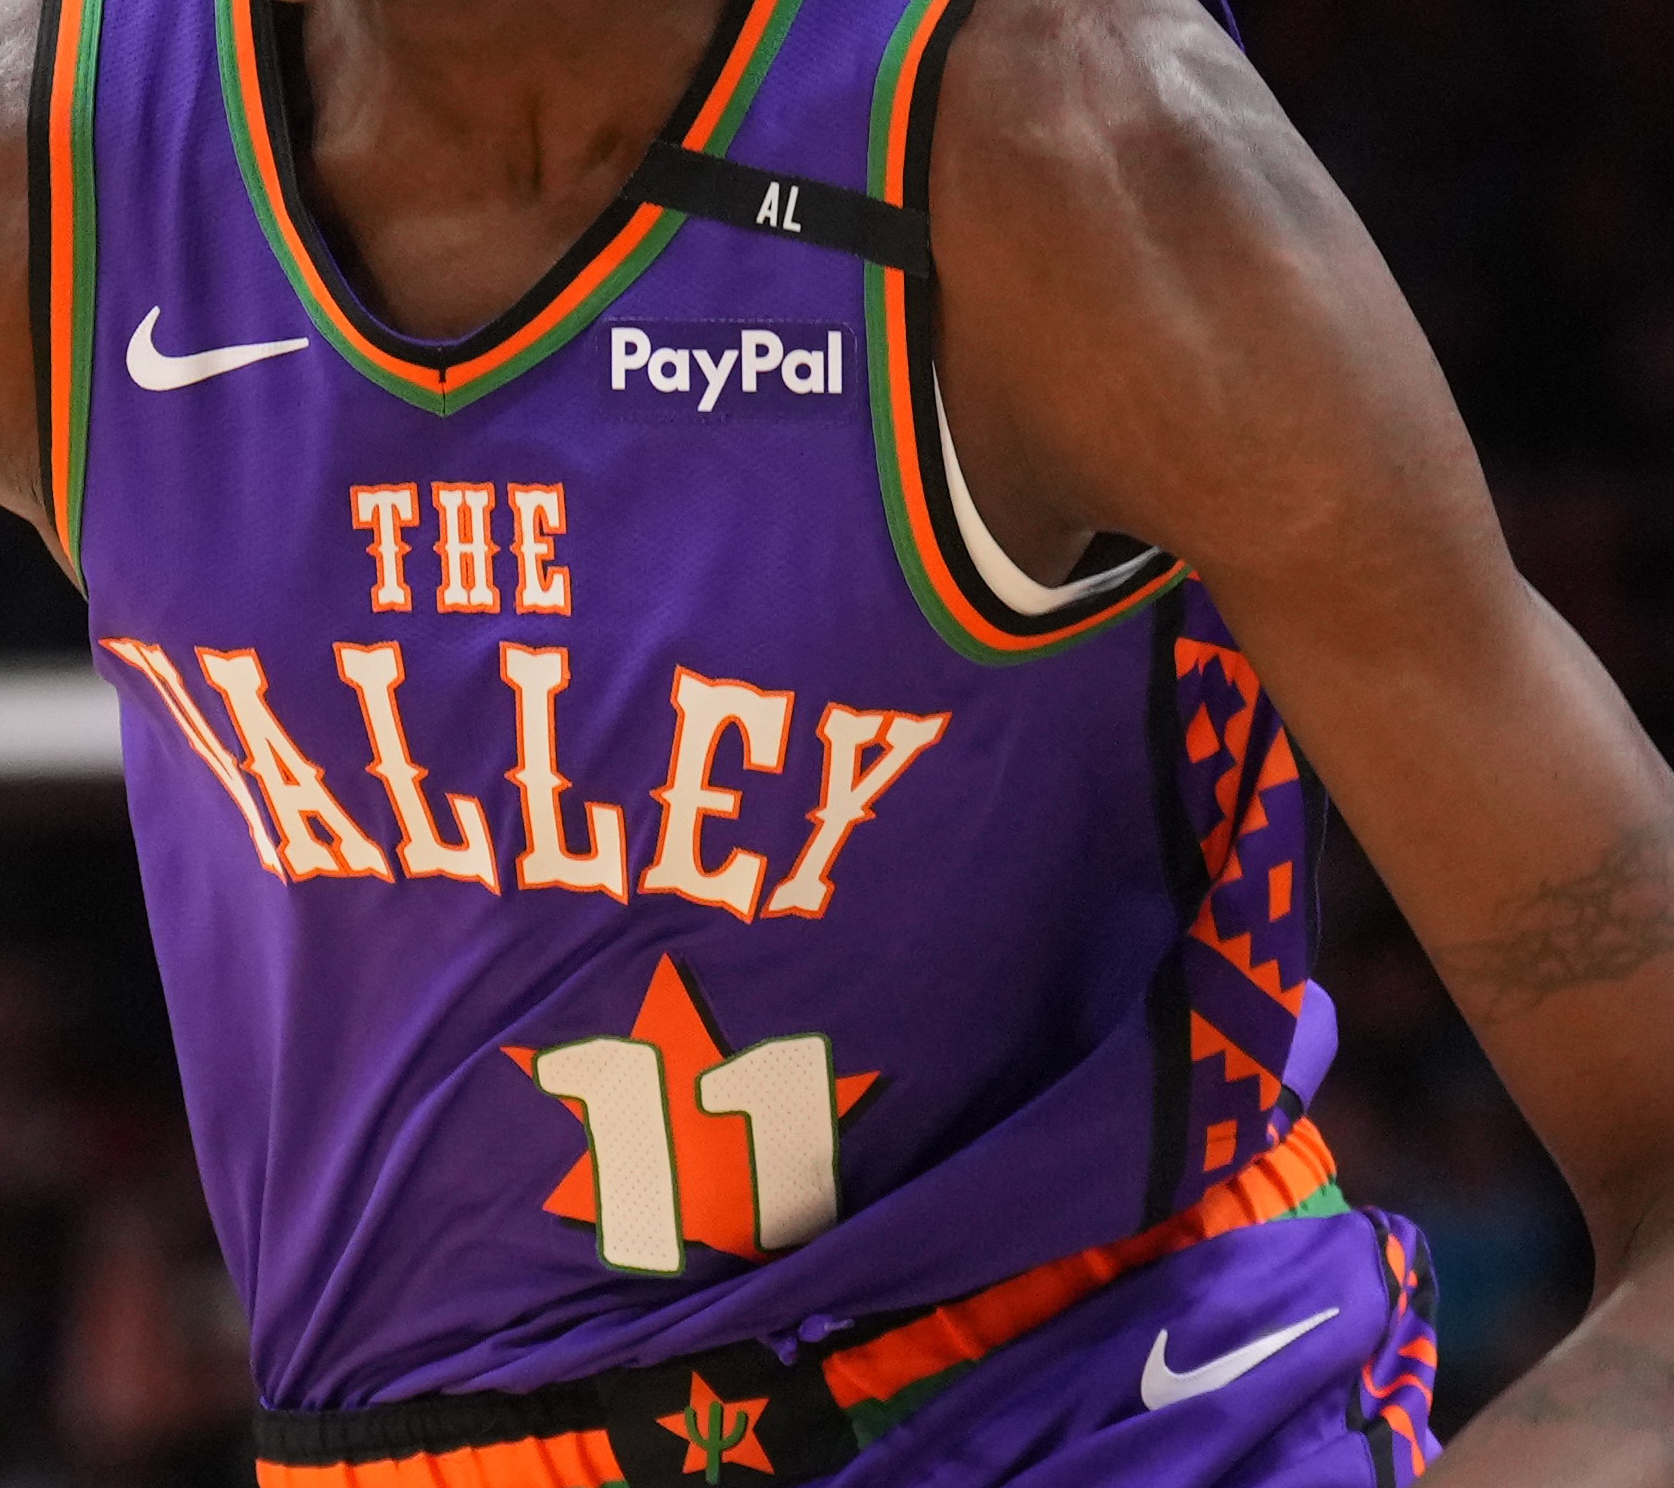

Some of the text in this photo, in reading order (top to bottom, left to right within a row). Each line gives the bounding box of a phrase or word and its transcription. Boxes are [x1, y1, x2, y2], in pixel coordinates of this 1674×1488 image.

[755, 180, 802, 233] AL
[610, 326, 843, 413] PayPal
[351, 481, 572, 618] THE
[98, 636, 953, 925] VALLEY
[531, 1031, 840, 1276] 11
